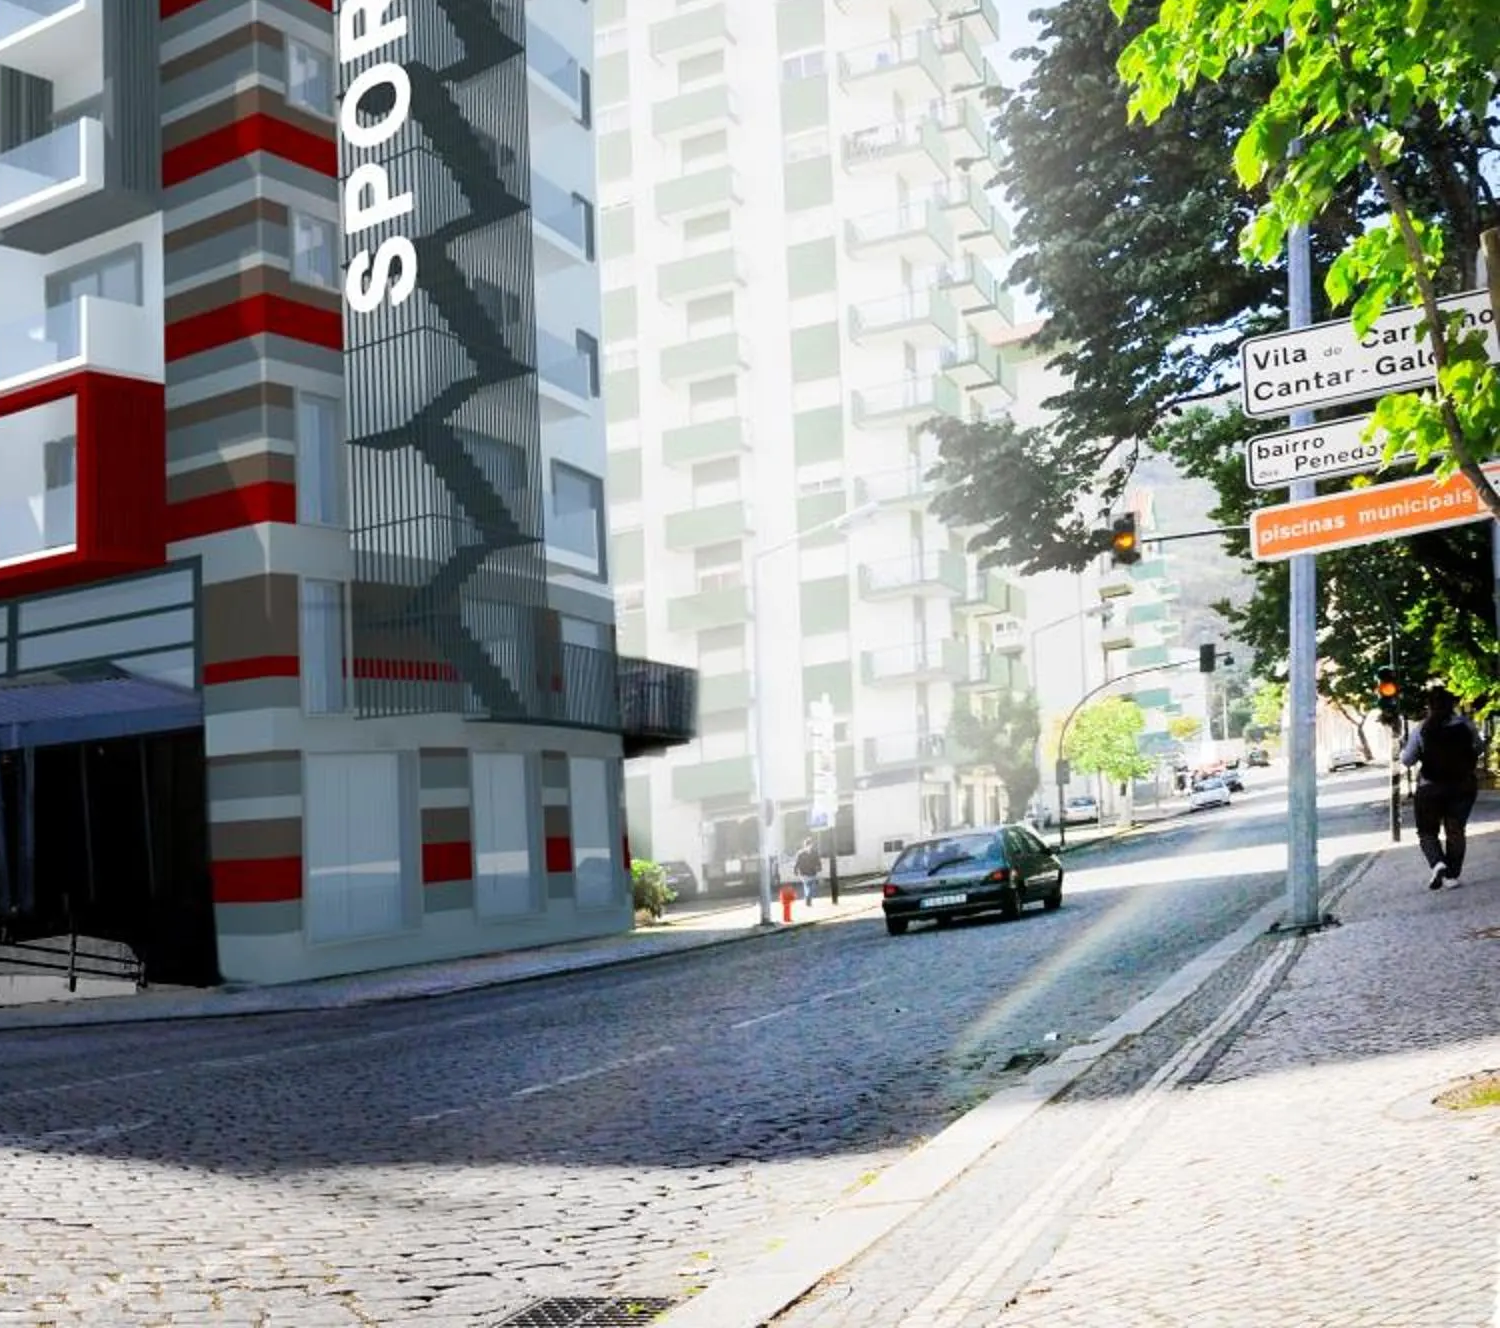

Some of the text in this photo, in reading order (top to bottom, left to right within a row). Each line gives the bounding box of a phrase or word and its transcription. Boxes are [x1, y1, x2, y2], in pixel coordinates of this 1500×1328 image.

[1253, 347, 1307, 370] Vila
[1257, 436, 1325, 460] bairro
[1259, 487, 1473, 546] piscinas municipais
